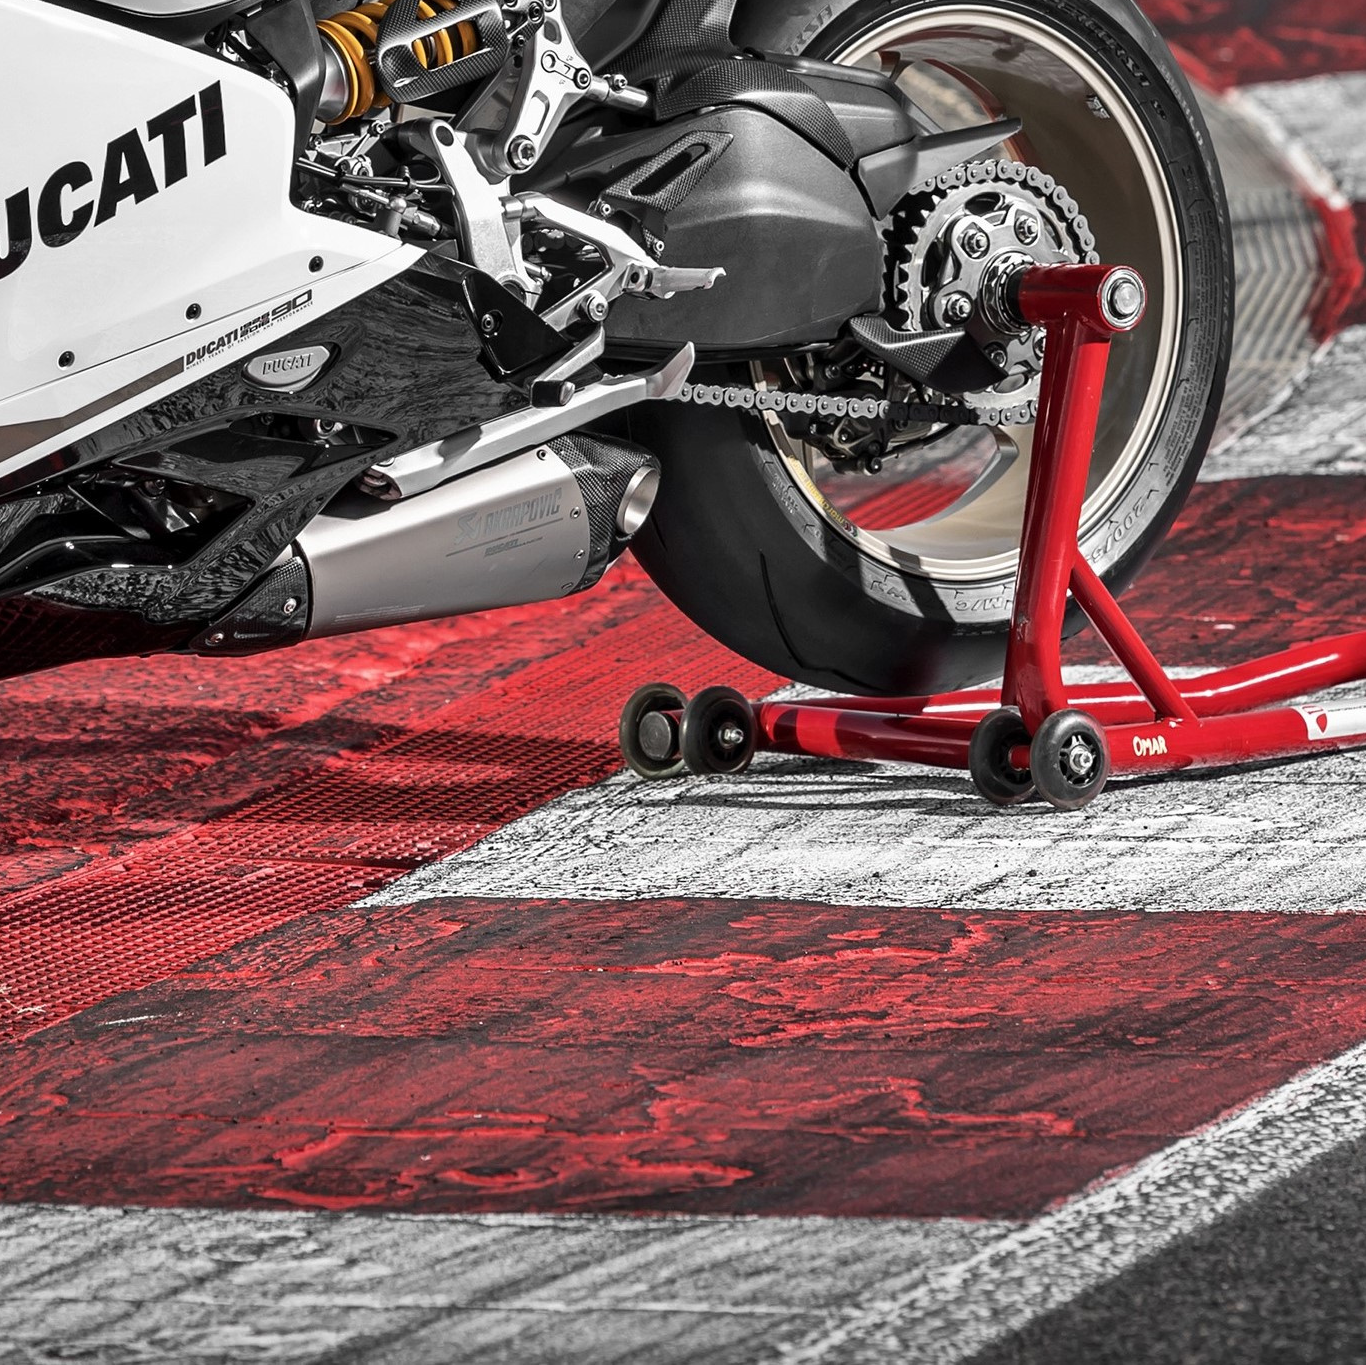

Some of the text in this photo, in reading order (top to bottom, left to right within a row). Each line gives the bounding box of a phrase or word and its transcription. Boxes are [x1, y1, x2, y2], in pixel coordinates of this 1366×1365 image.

[186, 328, 239, 366] DUCATI
[271, 288, 313, 321] 90
[262, 353, 313, 375] DUCATI
[1131, 734, 1169, 757] OMAR
